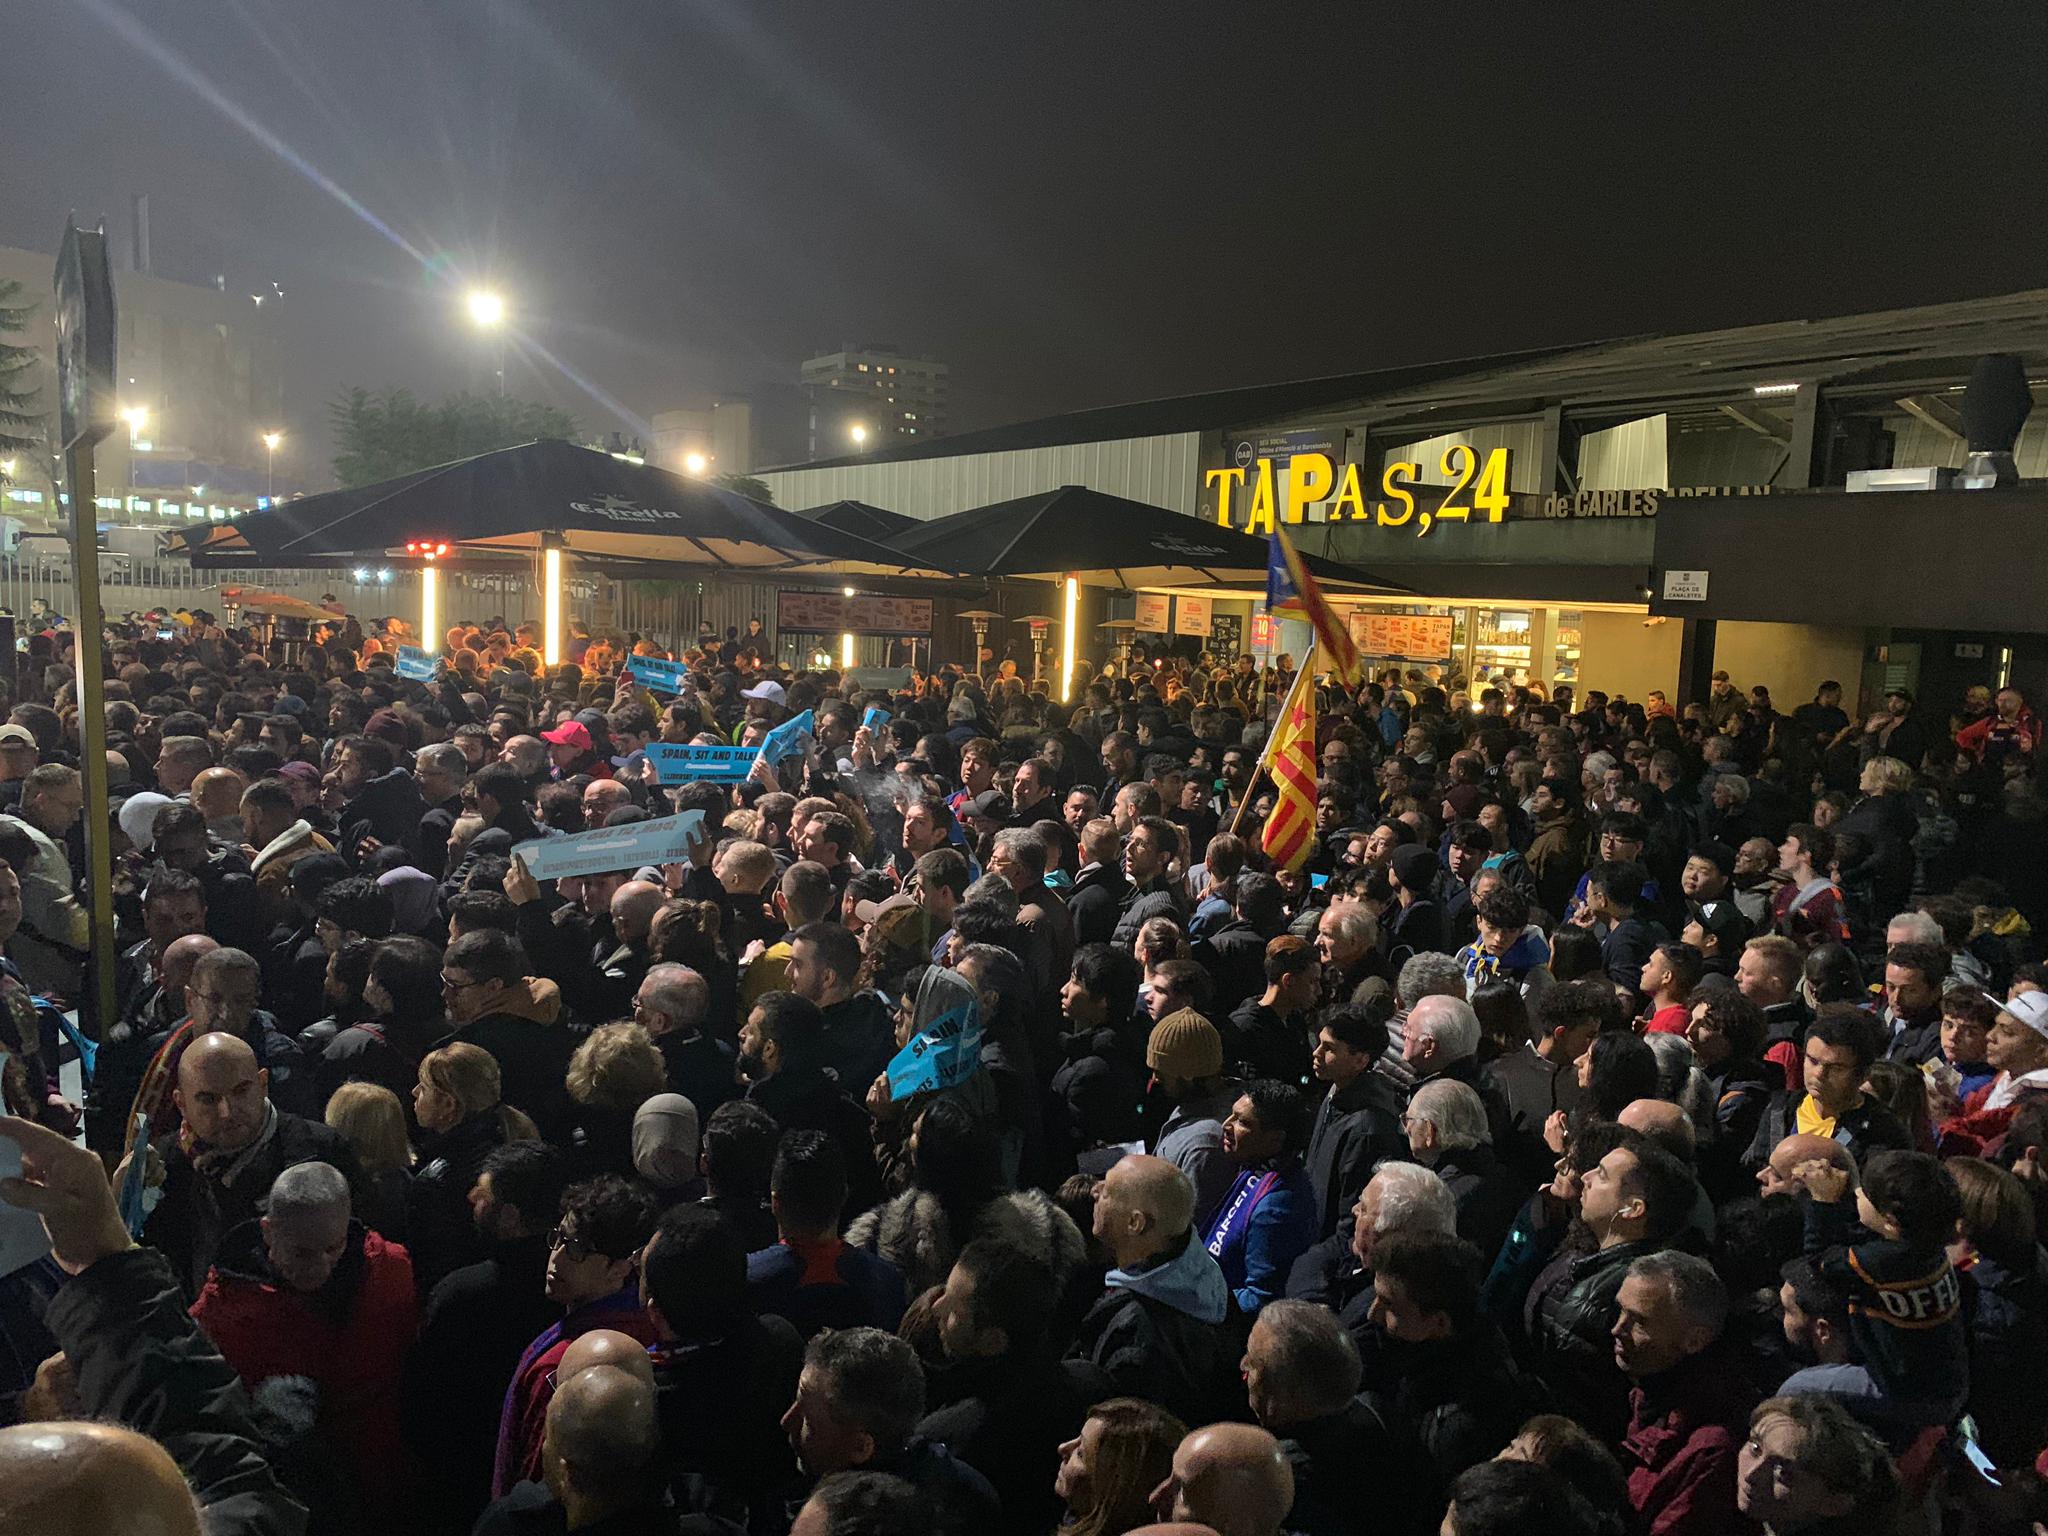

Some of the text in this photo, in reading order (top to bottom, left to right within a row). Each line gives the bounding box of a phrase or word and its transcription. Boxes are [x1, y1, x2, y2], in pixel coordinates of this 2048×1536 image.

[1544, 491, 1569, 518] de
[1574, 488, 1658, 517] CARLES
[662, 748, 691, 760] SPAIN,
[695, 750, 709, 760] SIT
[712, 751, 731, 760] AND
